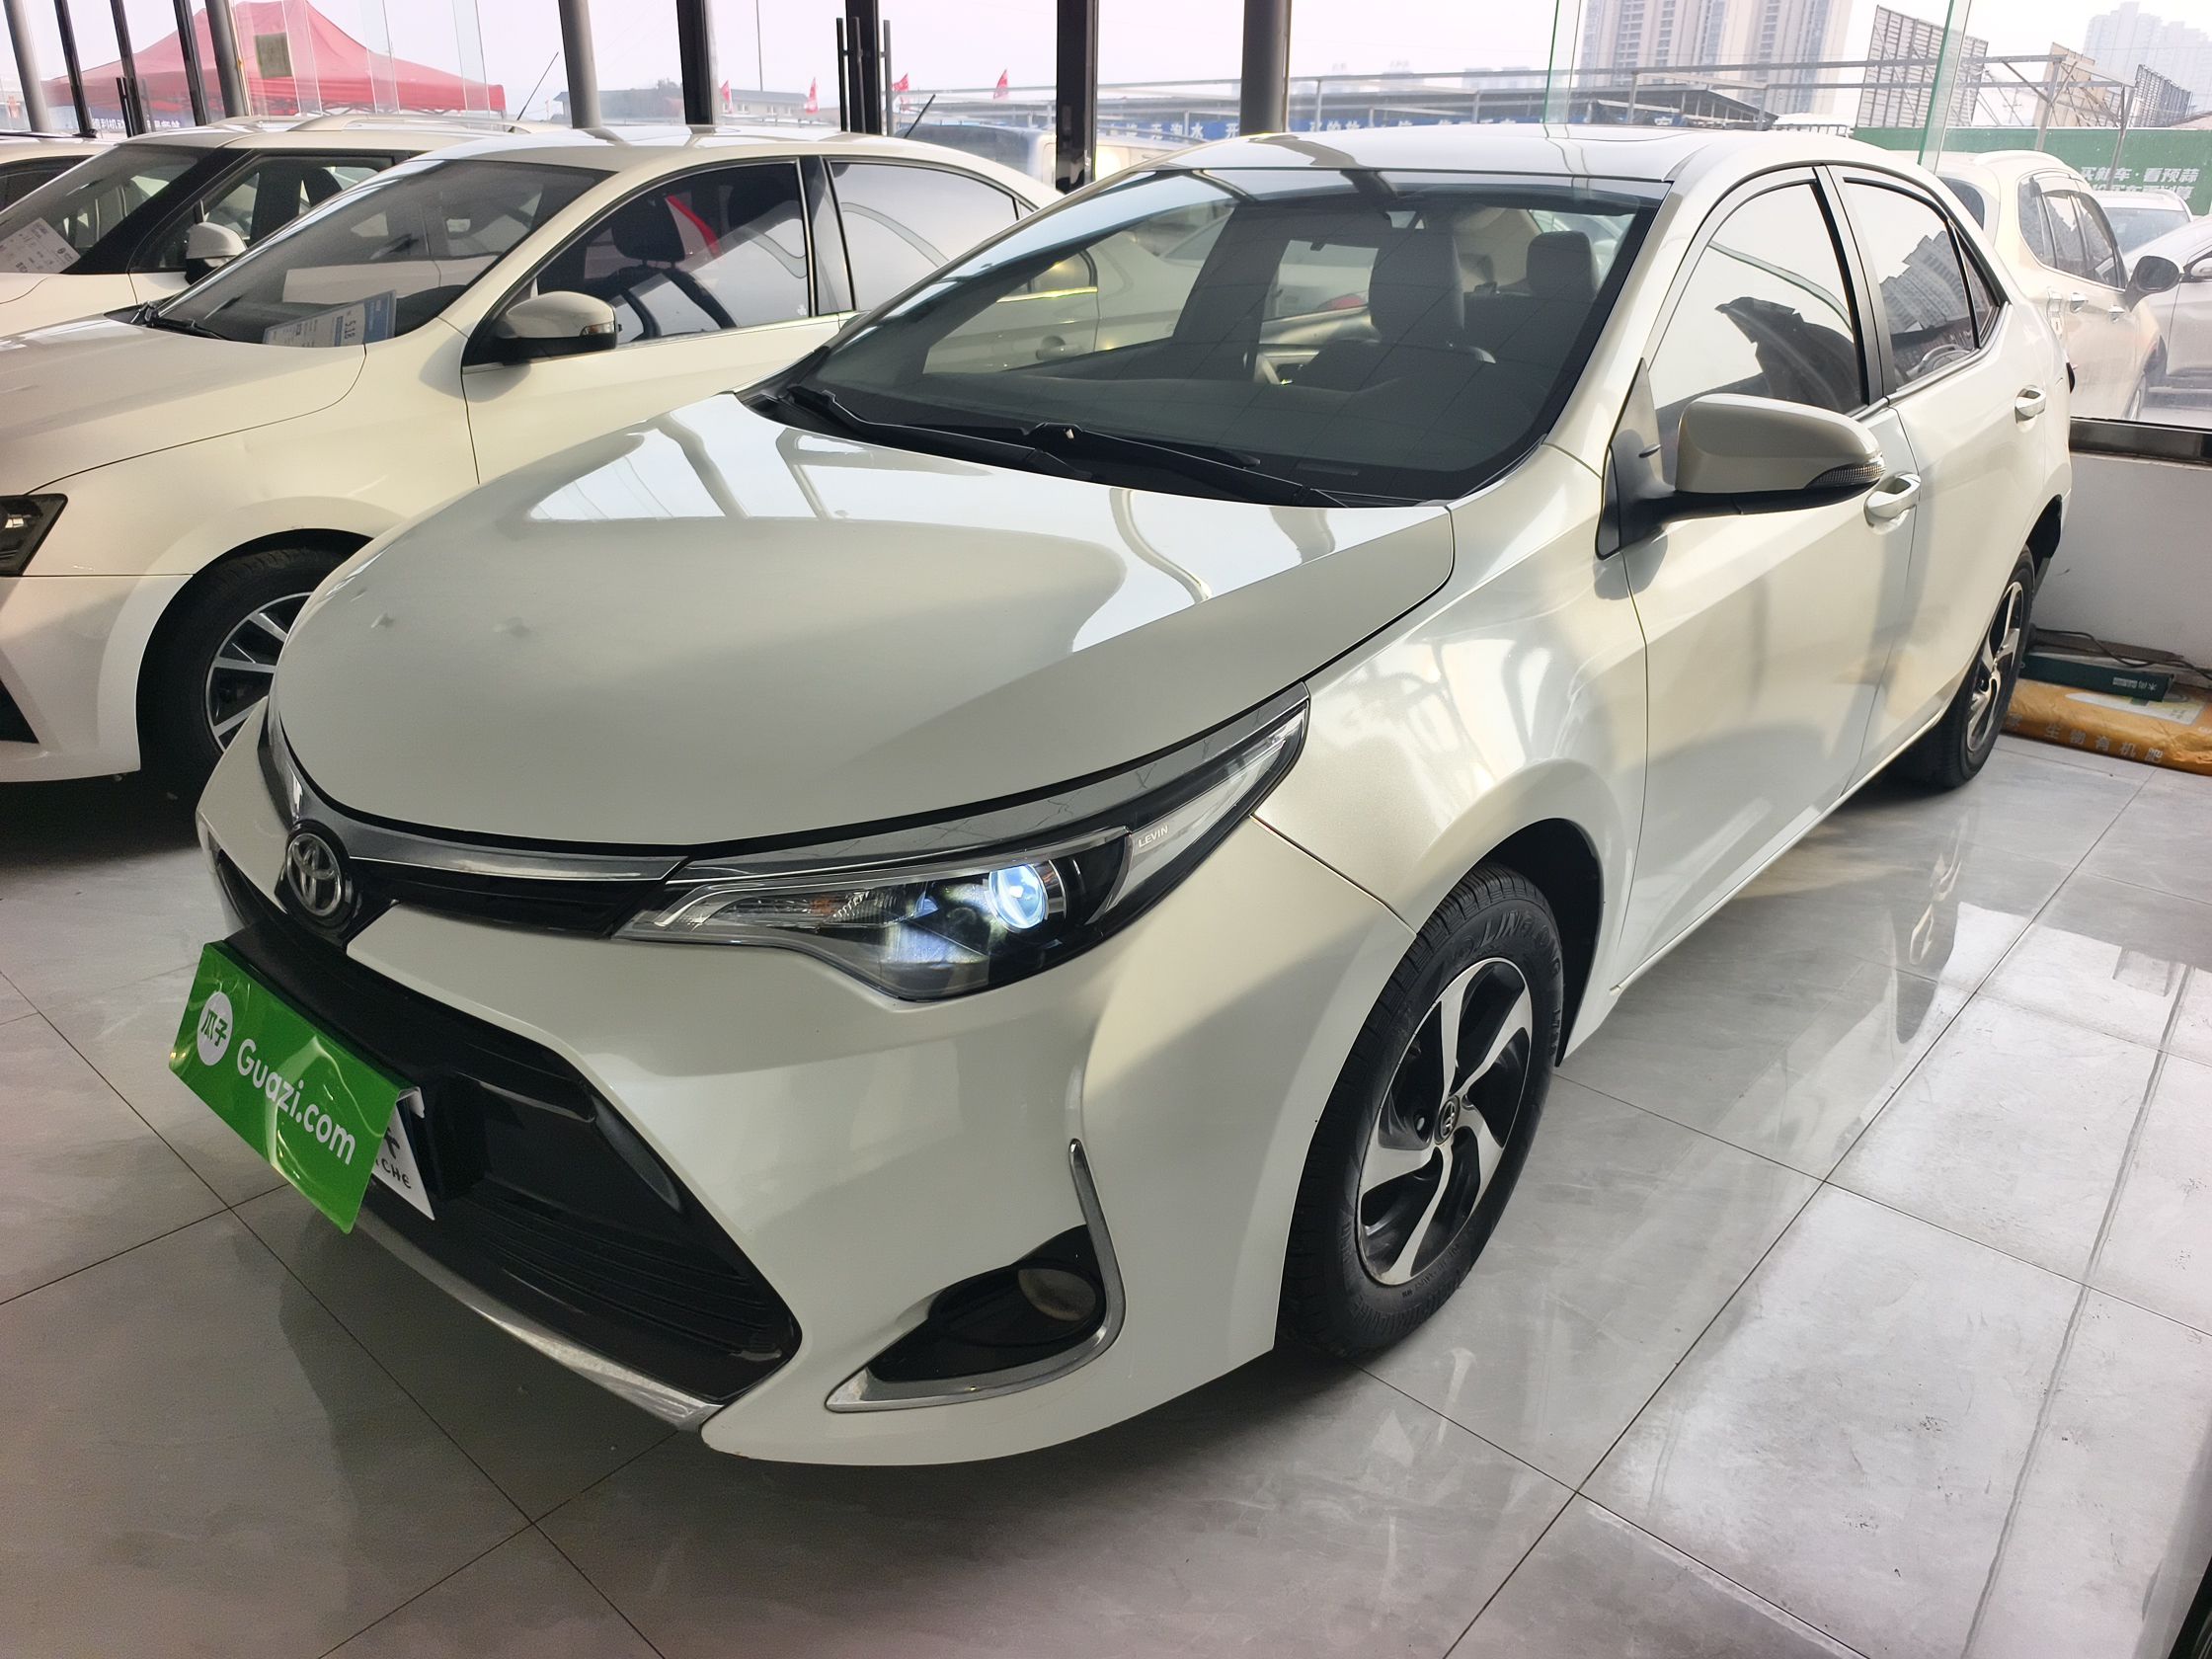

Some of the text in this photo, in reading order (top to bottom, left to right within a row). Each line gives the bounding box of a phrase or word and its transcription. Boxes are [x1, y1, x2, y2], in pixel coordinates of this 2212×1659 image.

[1138, 824, 1169, 848] LEVIN
[200, 1007, 227, 1047] 瓜子
[236, 1038, 357, 1166] Guazi.com
